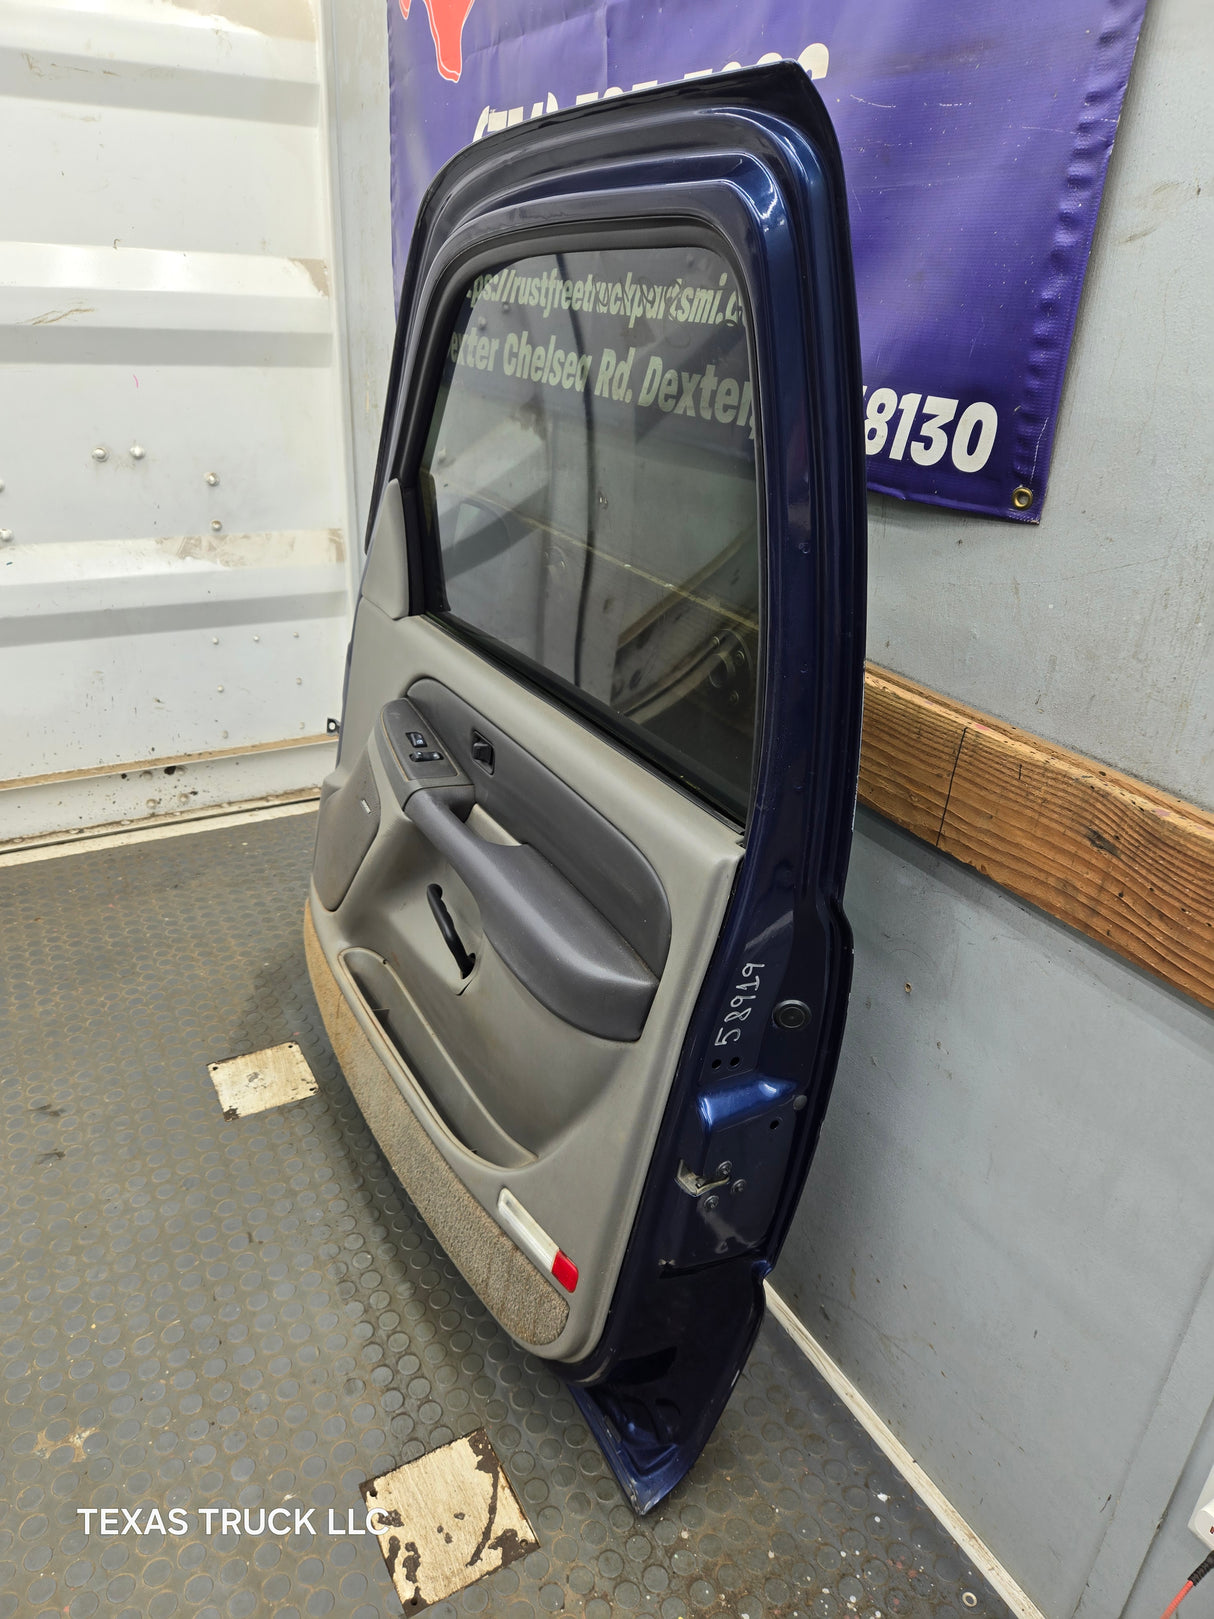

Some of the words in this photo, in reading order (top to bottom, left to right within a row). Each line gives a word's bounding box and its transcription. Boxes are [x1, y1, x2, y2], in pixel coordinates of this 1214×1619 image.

[467, 268, 747, 328] ps://rustfreetruckpartsmi.c
[449, 327, 500, 372] exter
[503, 330, 592, 392] Chelsea
[594, 346, 633, 404] Rd.
[862, 385, 998, 473] 8130
[714, 962, 766, 1047] 58919
